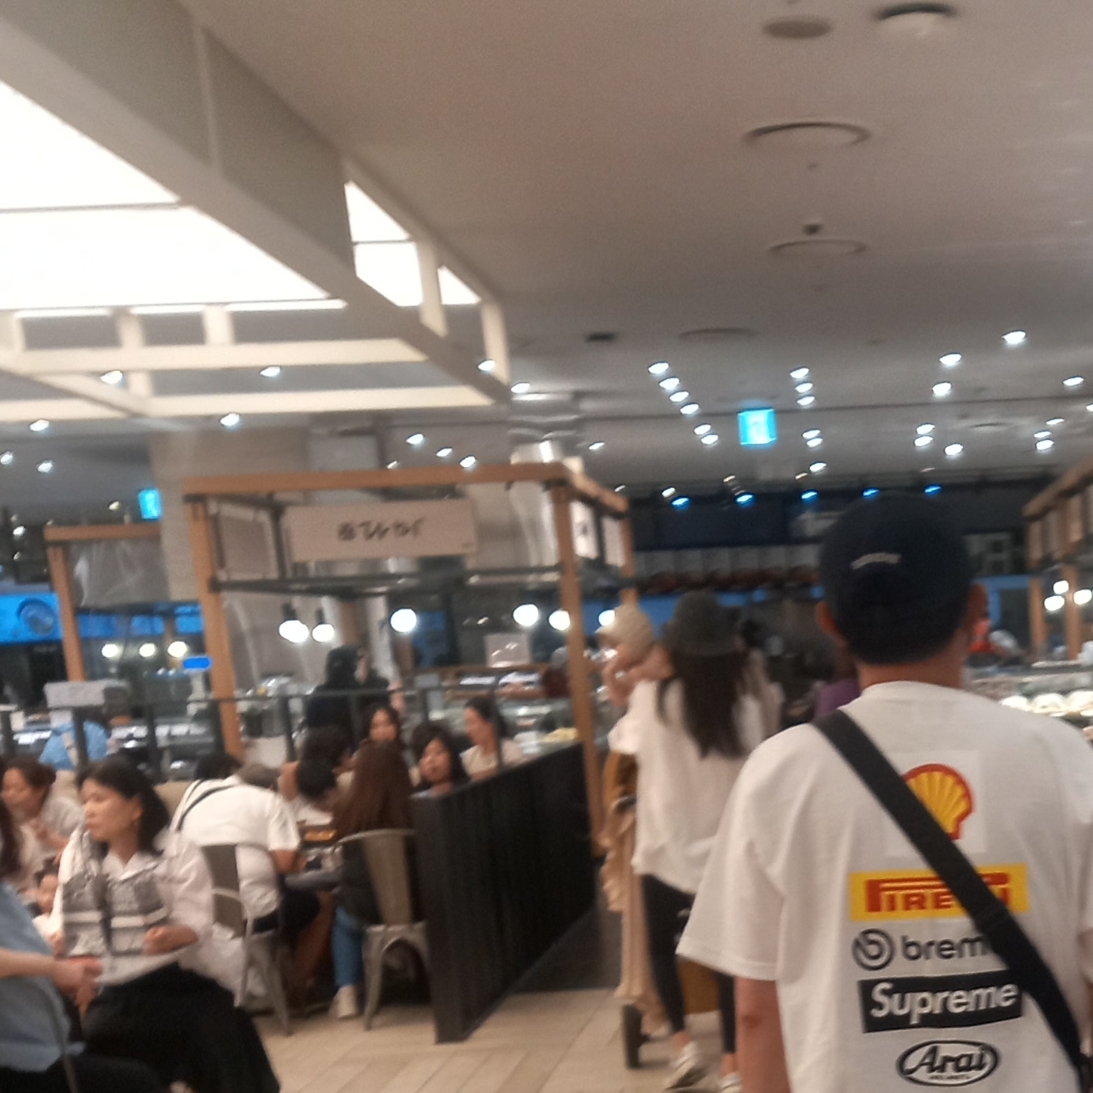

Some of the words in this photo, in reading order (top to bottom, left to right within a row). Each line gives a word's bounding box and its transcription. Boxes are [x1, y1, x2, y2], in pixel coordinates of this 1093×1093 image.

[865, 871, 1010, 913] PIREI
[901, 934, 989, 961] brem
[869, 981, 1020, 1025] Supreme
[902, 1044, 988, 1076] Arai
